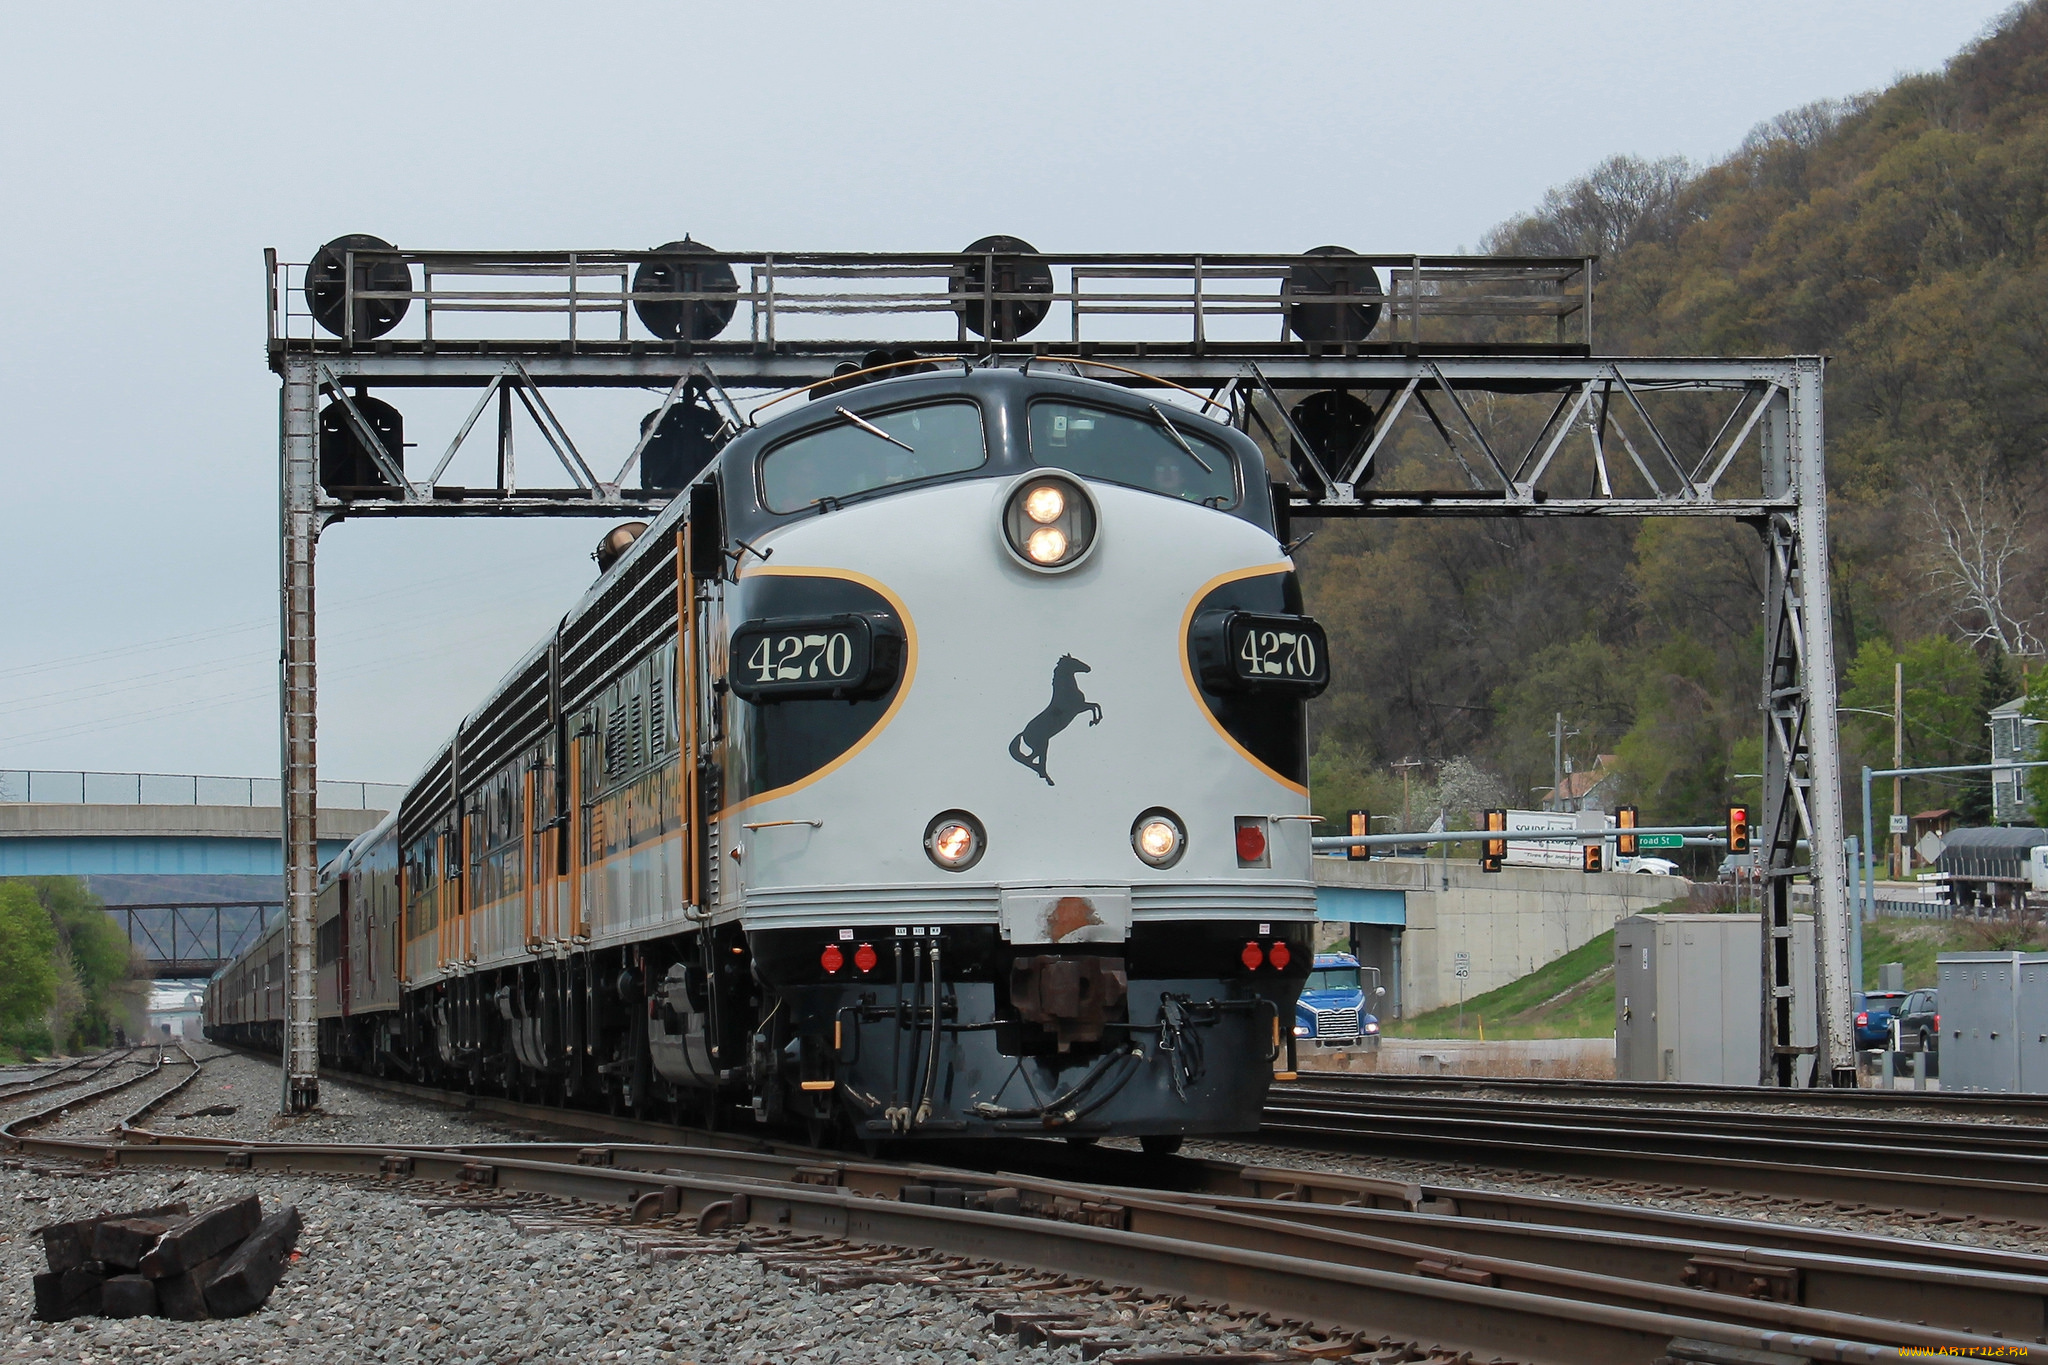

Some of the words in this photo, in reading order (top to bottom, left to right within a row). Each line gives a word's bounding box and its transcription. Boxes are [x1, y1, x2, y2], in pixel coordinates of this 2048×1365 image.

[747, 632, 852, 682] 4270
[1240, 630, 1316, 677] 4270
[1639, 837, 1659, 845] road
[1661, 836, 1670, 845] St
